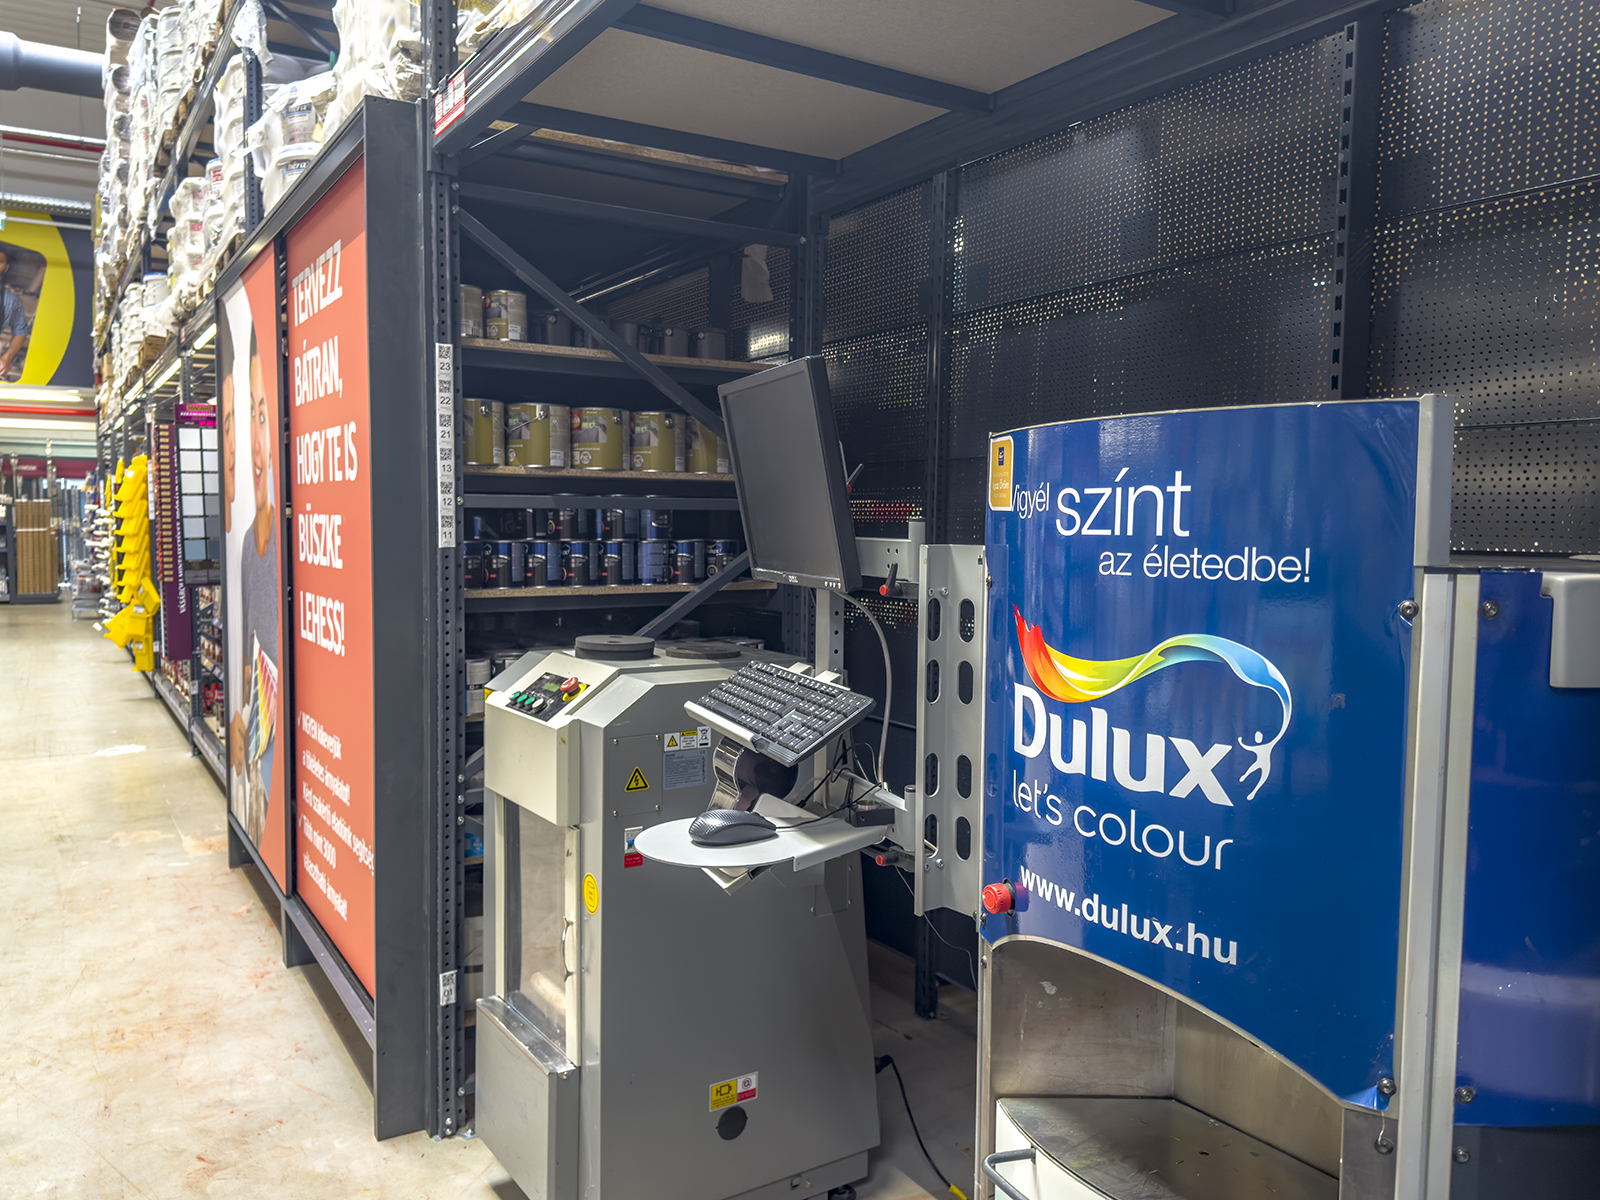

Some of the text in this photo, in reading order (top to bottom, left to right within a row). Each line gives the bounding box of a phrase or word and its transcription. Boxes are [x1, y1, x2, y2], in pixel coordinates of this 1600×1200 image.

[292, 239, 342, 327] TERVEZZ
[294, 335, 342, 407] BÁTRAN,
[440, 362, 451, 370] 23
[440, 397, 451, 405] 22
[296, 421, 358, 485] HOGY TE IS
[443, 498, 453, 506] 12
[443, 531, 452, 539] 11
[1056, 467, 1191, 537] színt
[298, 503, 343, 569] BÜSZKE
[1099, 544, 1310, 583] az életedbe!
[300, 590, 345, 656] LEHESS!
[1013, 682, 1234, 807] Dulux
[1013, 769, 1234, 870] let's colour
[323, 837, 336, 869] 3000
[1020, 865, 1237, 965] www.dulux.hu
